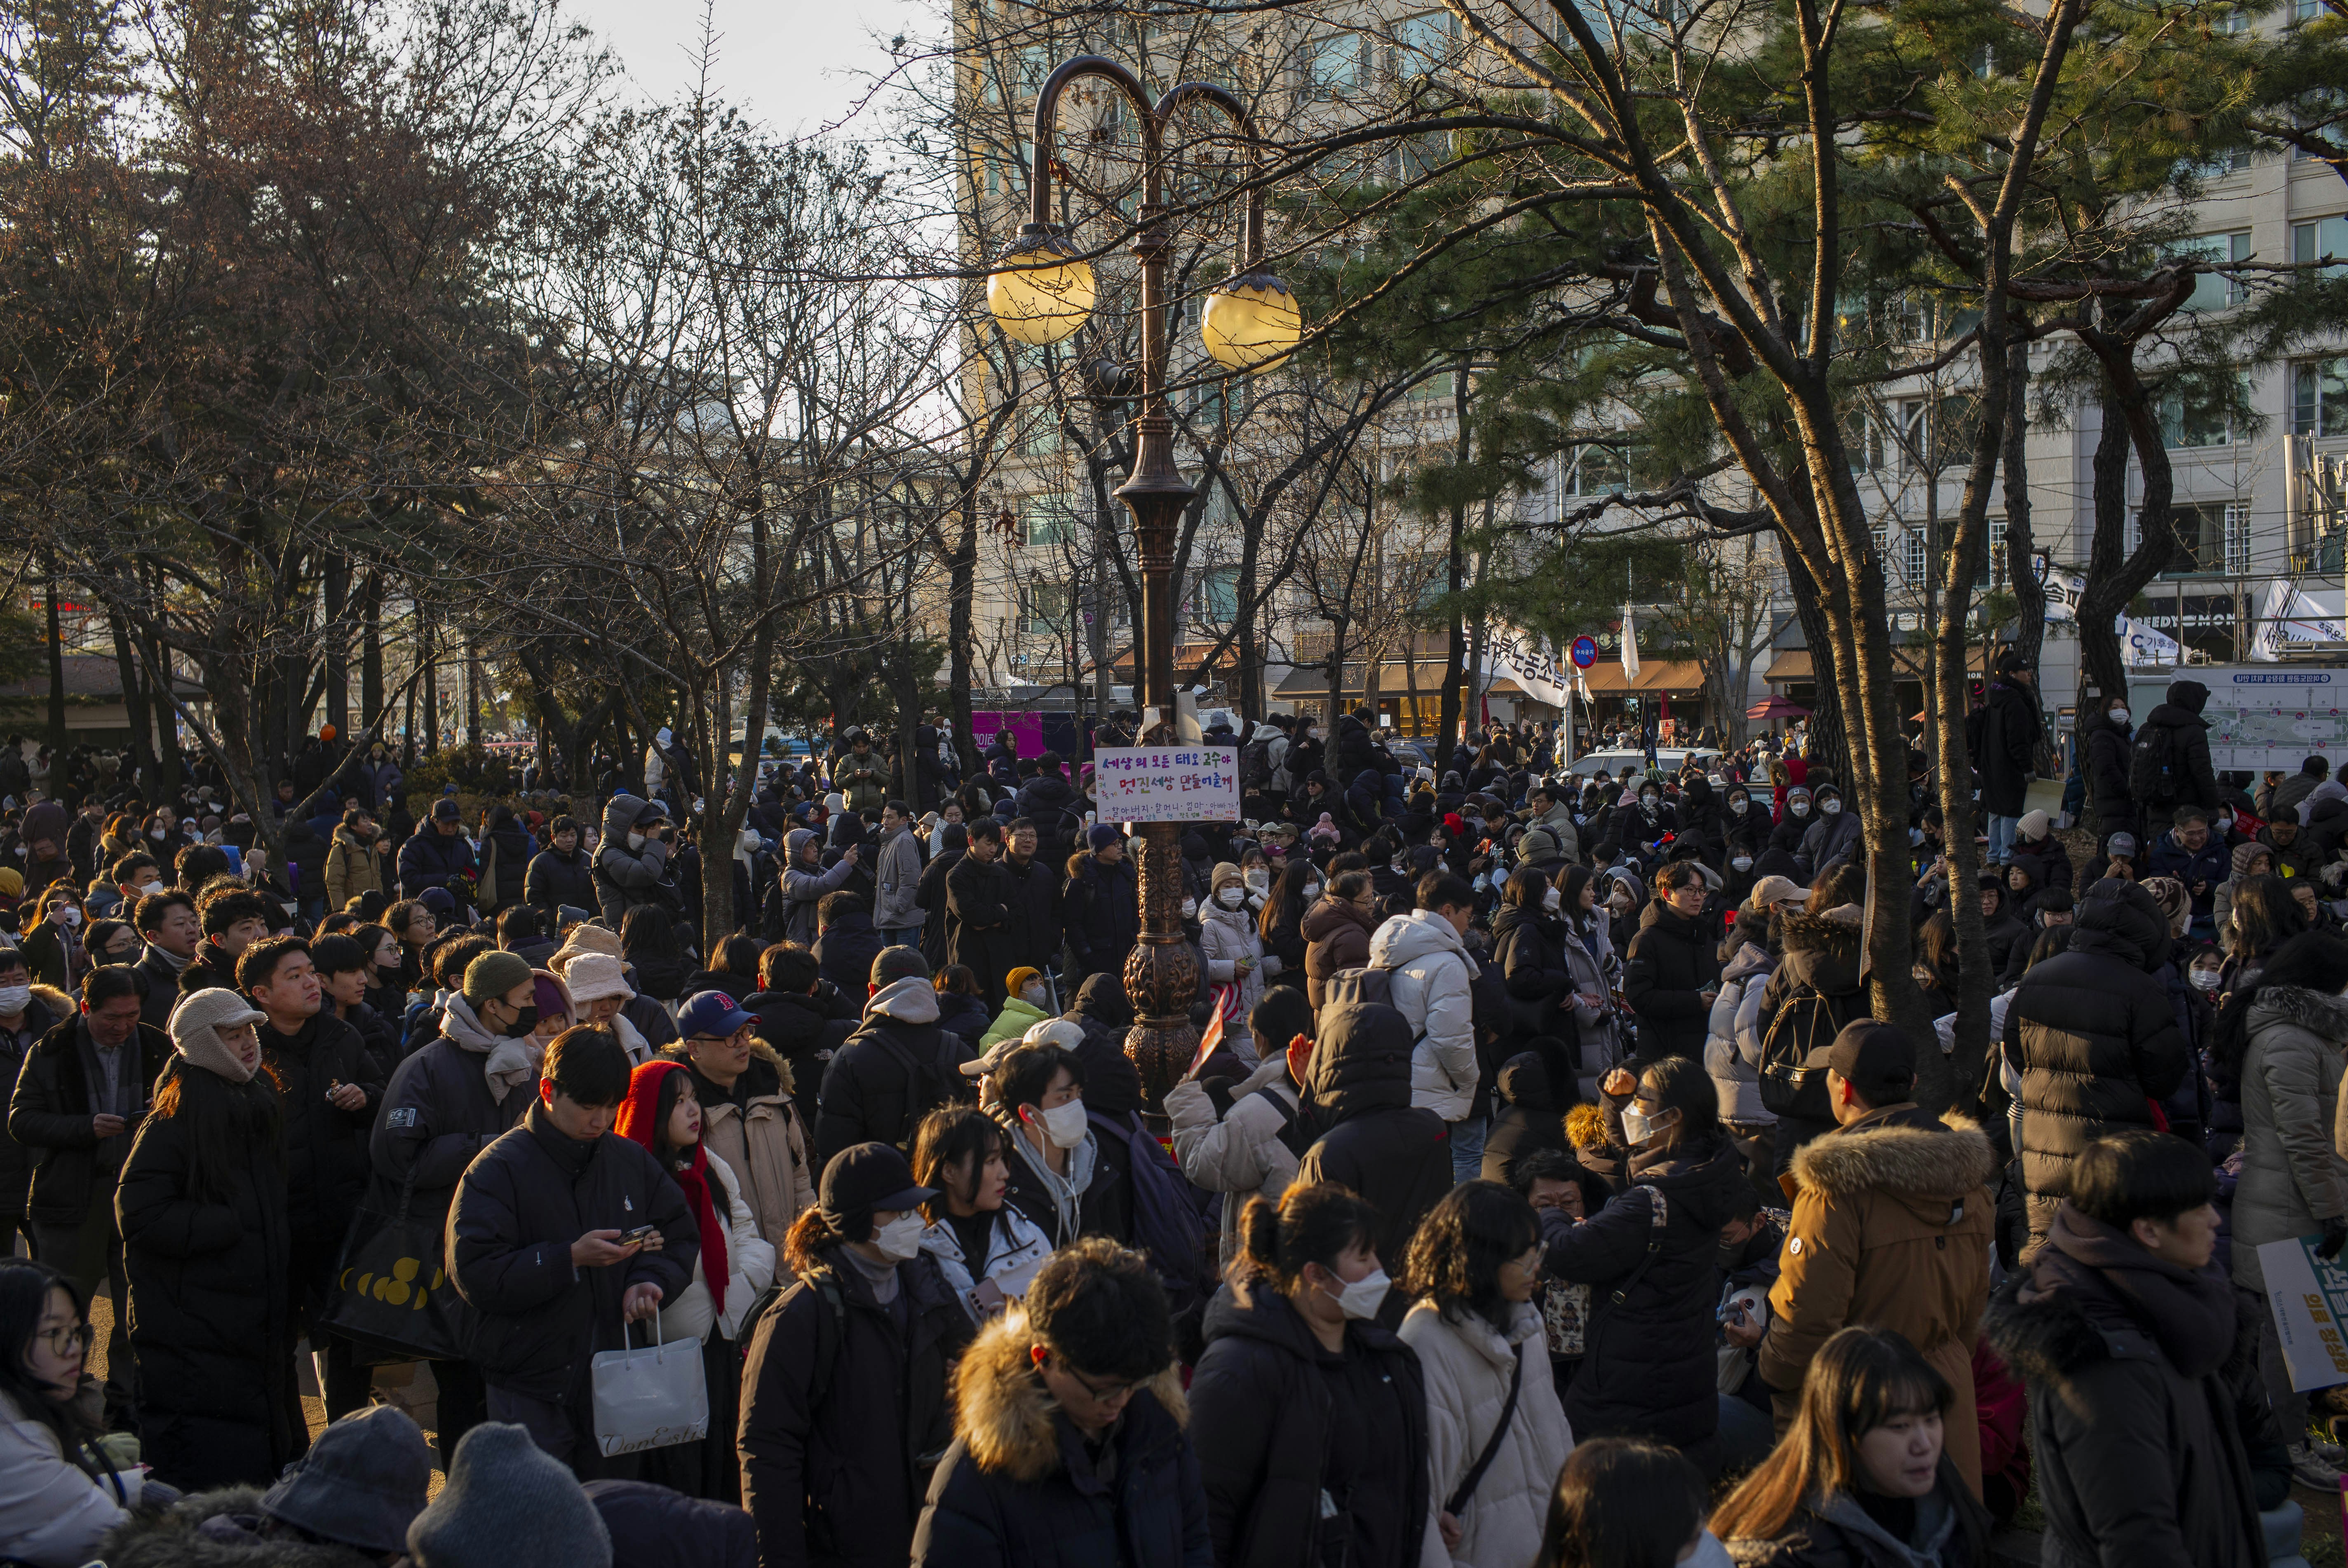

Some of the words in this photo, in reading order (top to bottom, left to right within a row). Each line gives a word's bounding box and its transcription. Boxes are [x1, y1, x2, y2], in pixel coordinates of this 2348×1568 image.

[2132, 615, 2178, 628] REEDY
[1102, 757, 1147, 770] 세상의
[1152, 755, 1169, 769] 모든
[1180, 772, 1232, 793] 만들어줄게
[714, 993, 734, 1011] B
[2302, 1293, 2332, 1323] 의료
